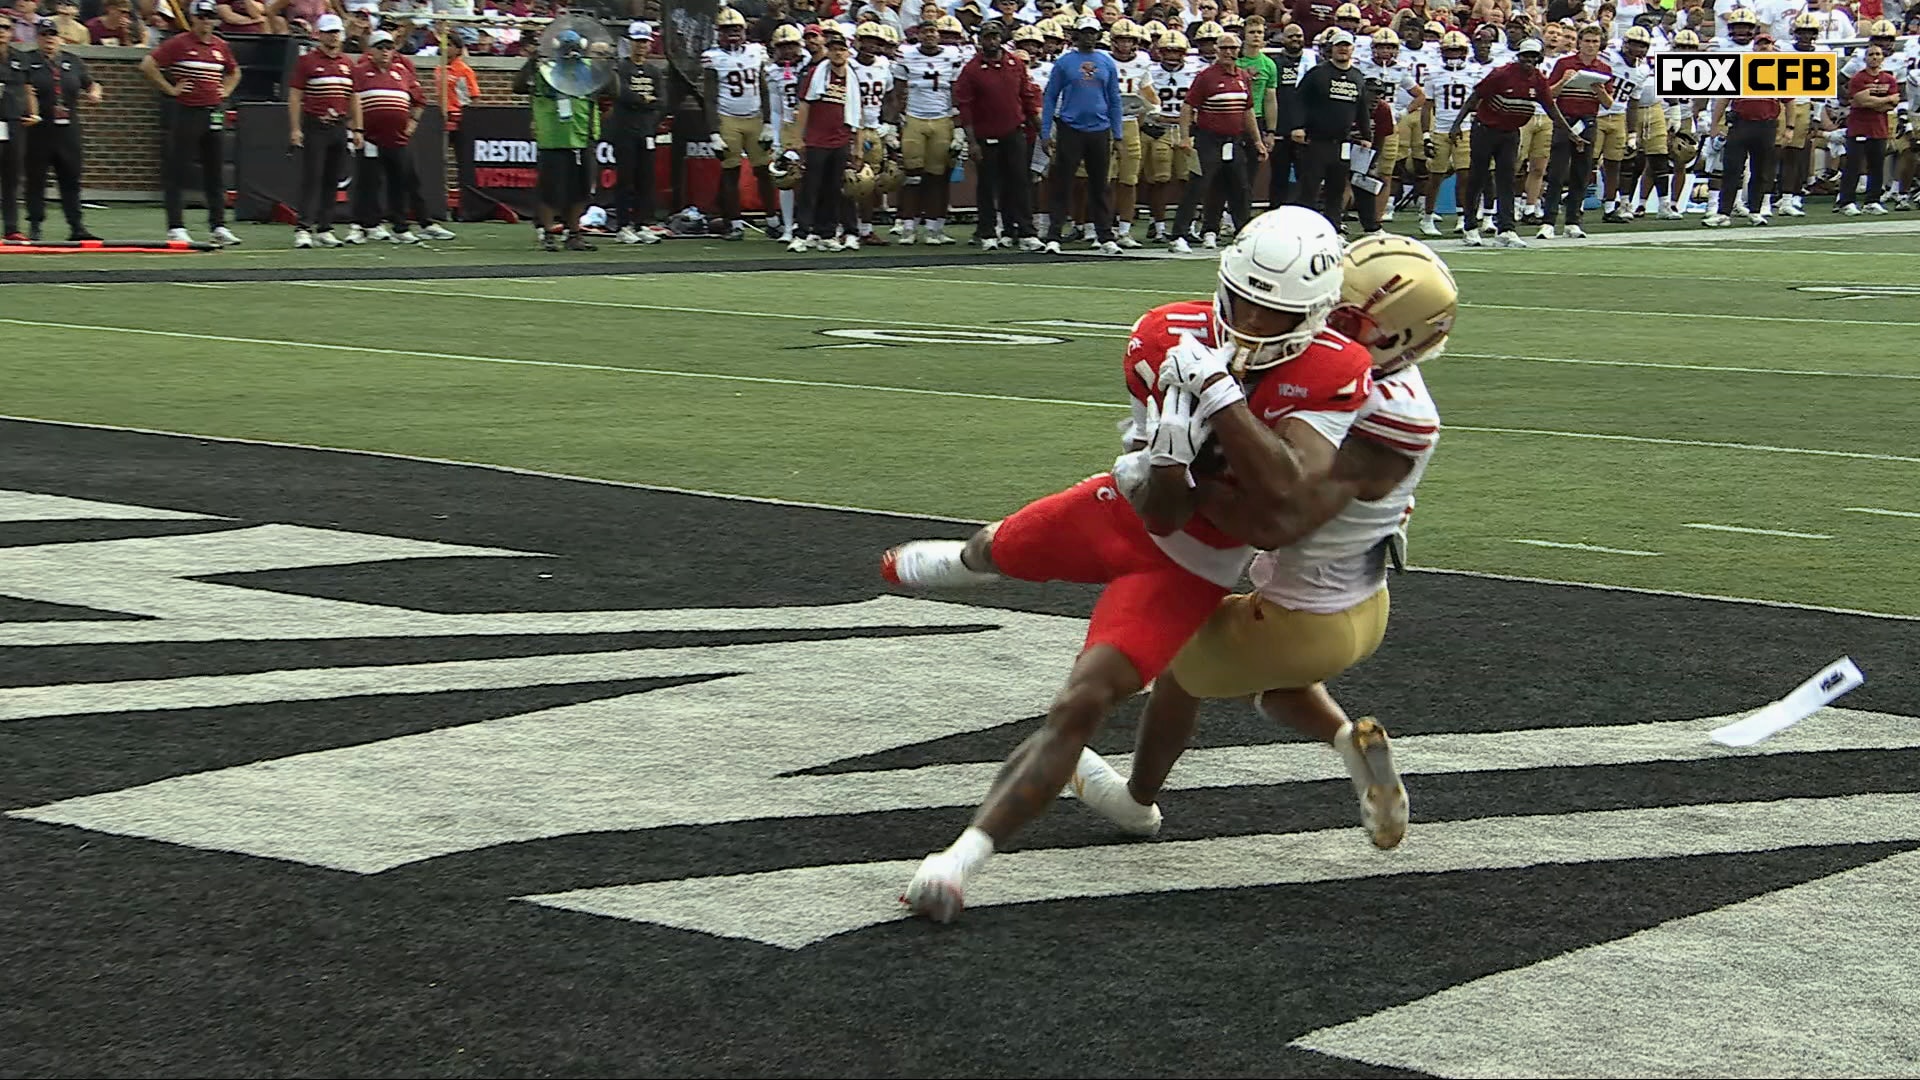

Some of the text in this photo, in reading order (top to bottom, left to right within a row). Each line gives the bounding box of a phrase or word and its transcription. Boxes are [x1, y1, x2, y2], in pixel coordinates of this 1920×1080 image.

[727, 68, 757, 97] 94
[1443, 83, 1466, 110] 19
[474, 139, 538, 163] RESTRI
